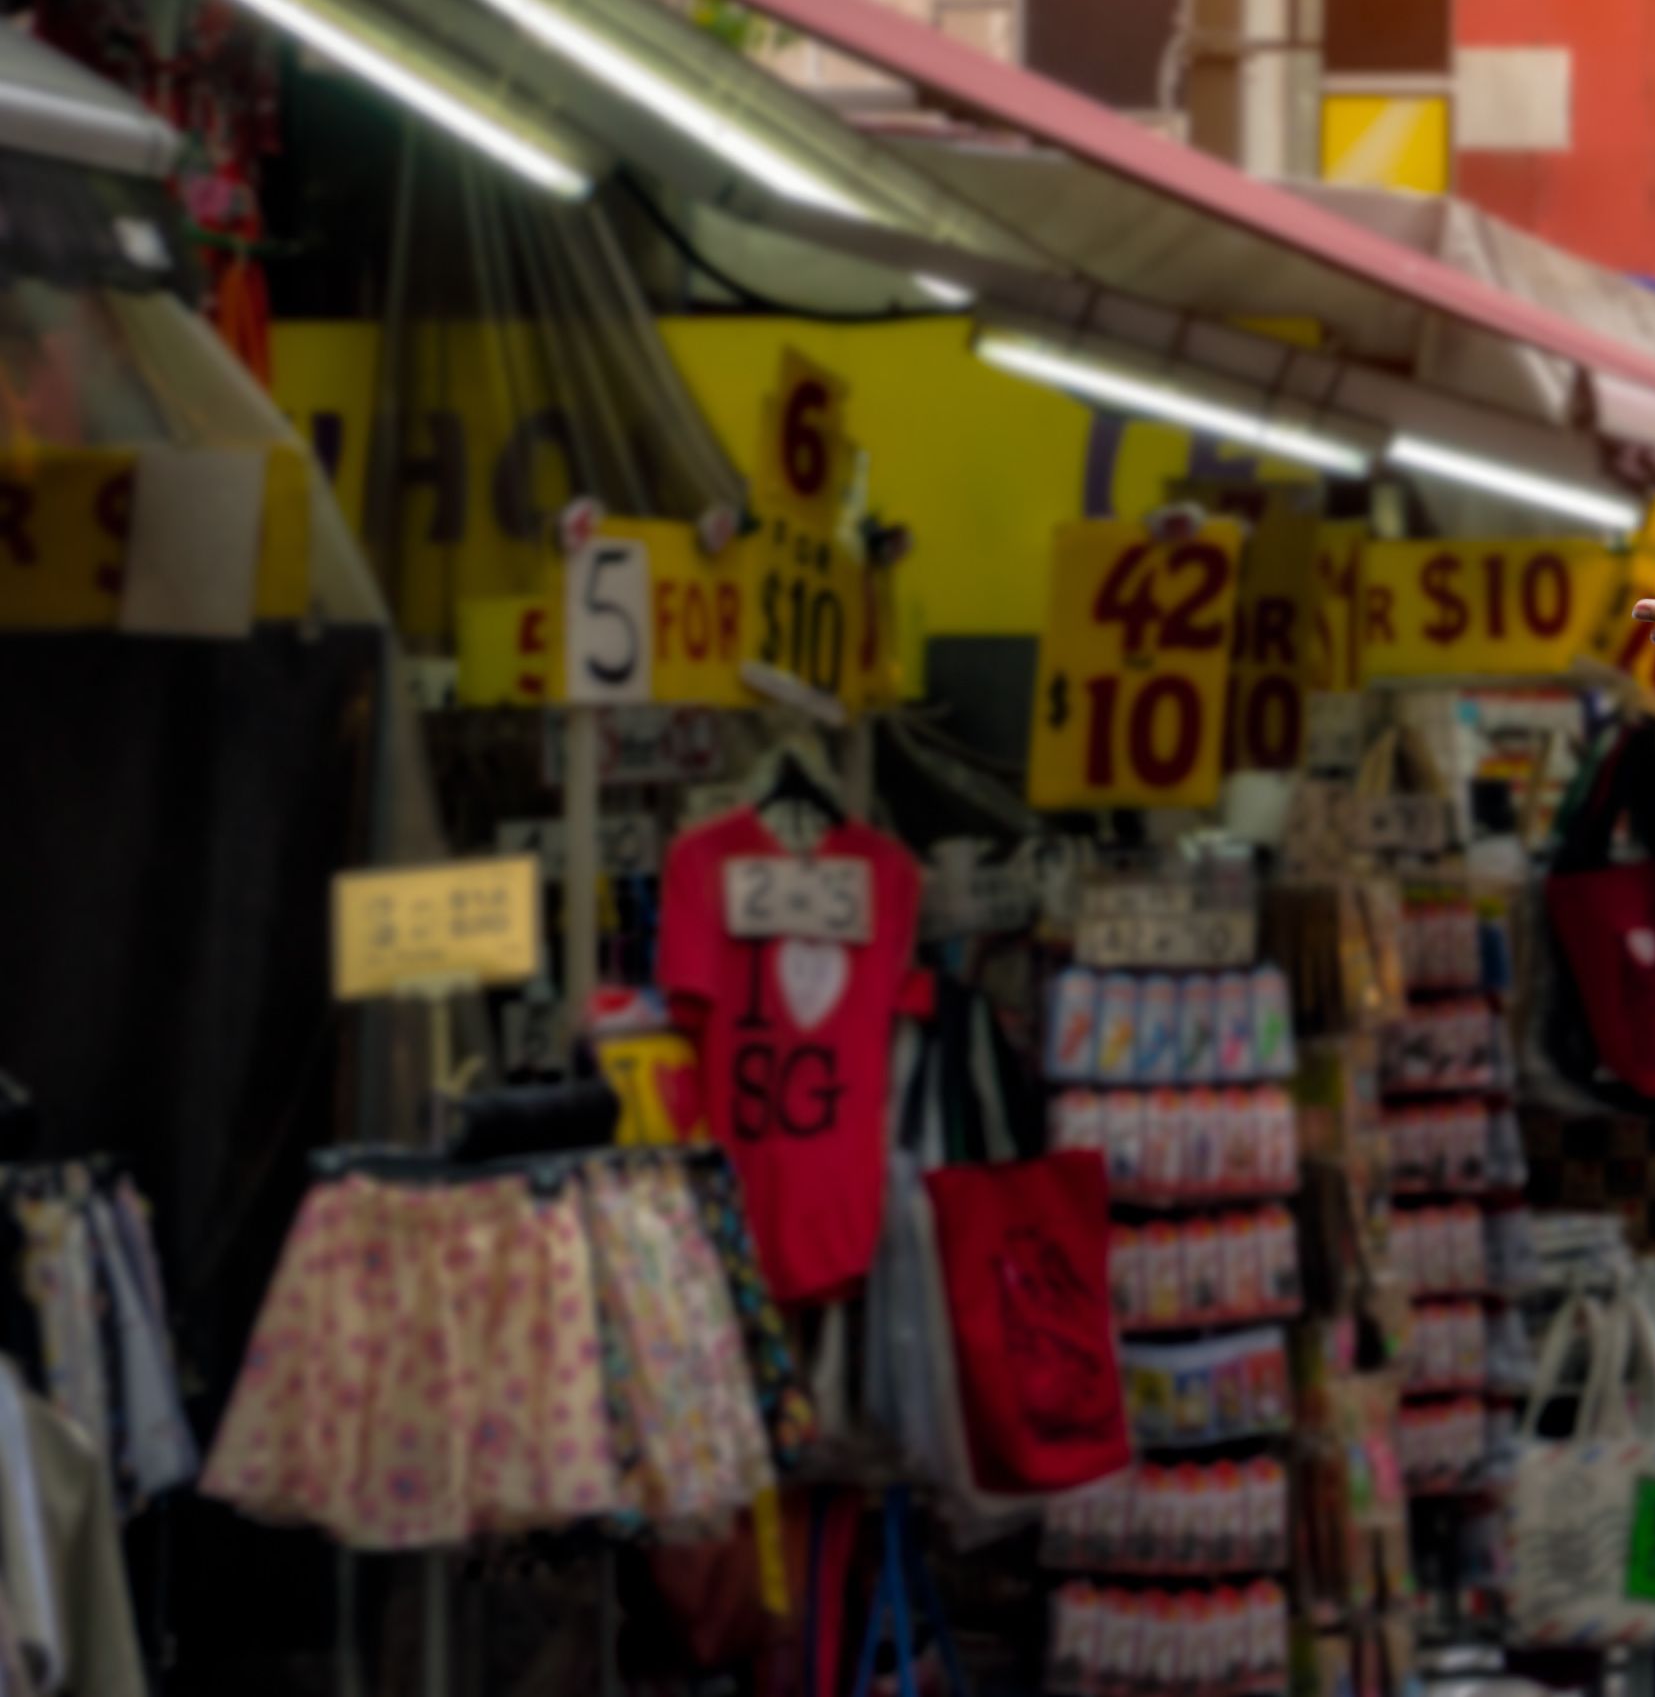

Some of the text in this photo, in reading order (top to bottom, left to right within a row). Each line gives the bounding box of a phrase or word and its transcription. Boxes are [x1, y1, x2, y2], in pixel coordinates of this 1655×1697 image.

[783, 380, 826, 495] 6
[585, 546, 638, 686] 5
[657, 579, 742, 663] FOR
[760, 567, 844, 698] $10
[1094, 545, 1229, 650] 42
[1422, 552, 1572, 643] $10
[733, 1043, 848, 1138] SG
